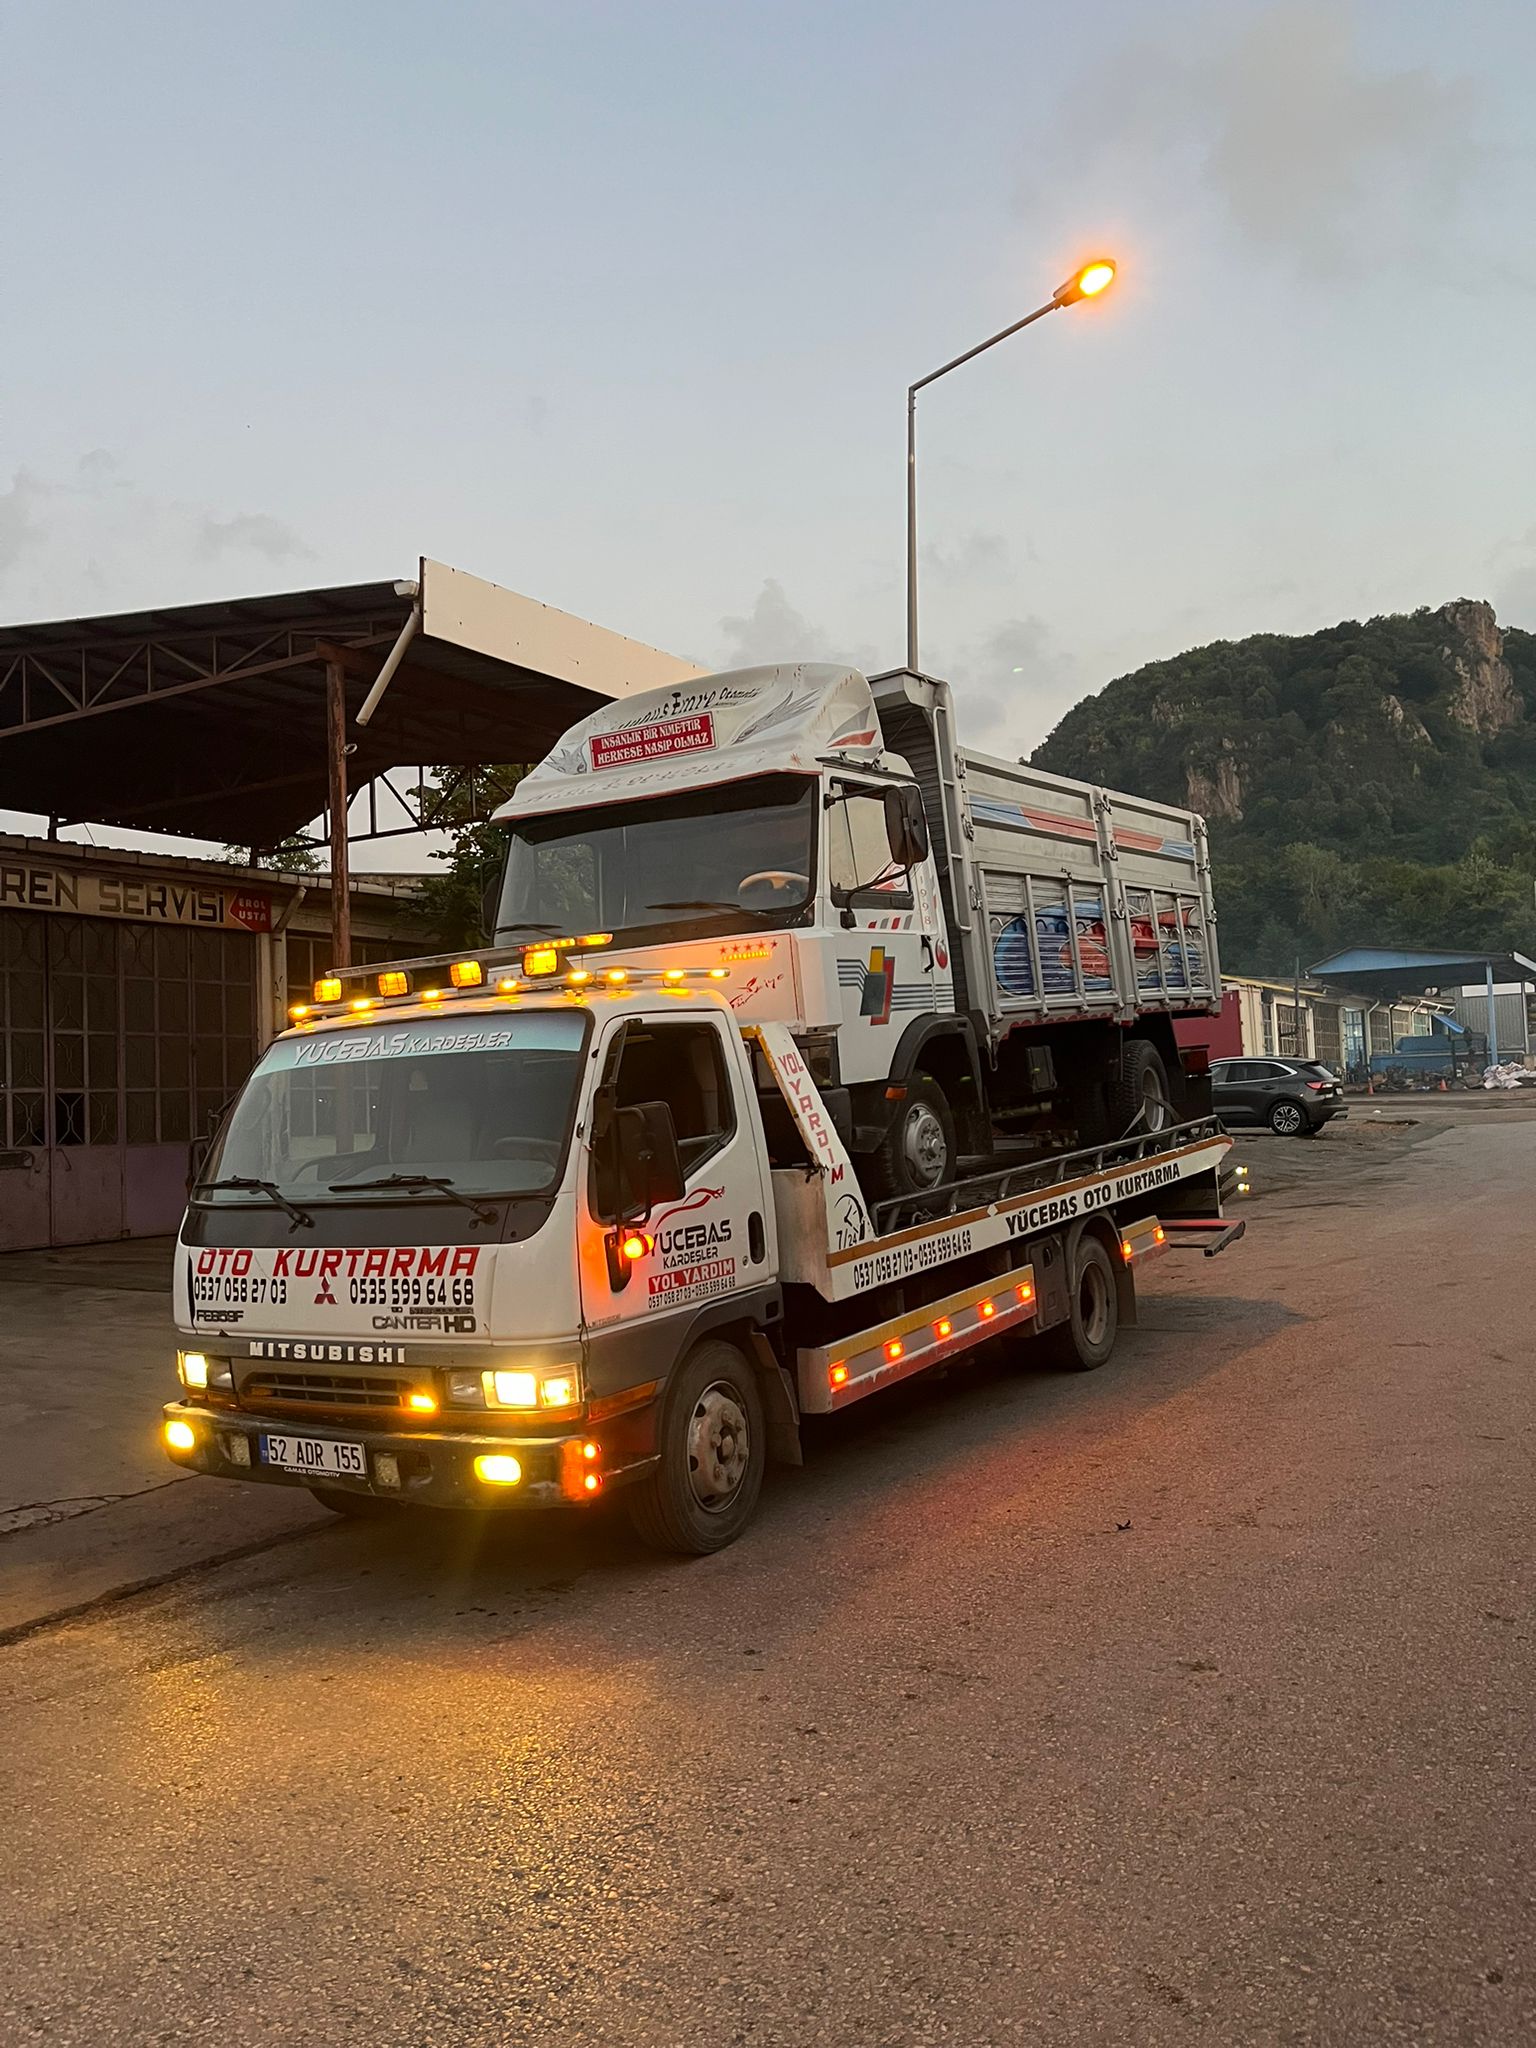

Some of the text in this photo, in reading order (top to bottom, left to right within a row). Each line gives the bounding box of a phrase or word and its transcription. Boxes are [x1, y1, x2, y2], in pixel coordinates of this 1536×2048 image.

[597, 744, 644, 764] HERKESE
[673, 732, 709, 748] OLMAZ
[238, 910, 267, 921] USTA
[1005, 1162, 1181, 1236] YÜCEBAŞ OTO KURTARMA
[836, 1228, 858, 1250] 7/24
[197, 1247, 481, 1278] OTO KURTARMA
[651, 1259, 734, 1293] YOL YARDIM
[853, 1260, 875, 1290] 0537
[875, 1255, 891, 1282] 058
[893, 1251, 902, 1277] 27
[194, 1275, 287, 1305] 0537 058 27 03
[349, 1277, 474, 1305] 0535 599 64 68
[372, 1315, 477, 1334] CANTER HD
[249, 1341, 406, 1364] MITSUBISHI
[268, 1437, 361, 1471] 52 ADR 155
